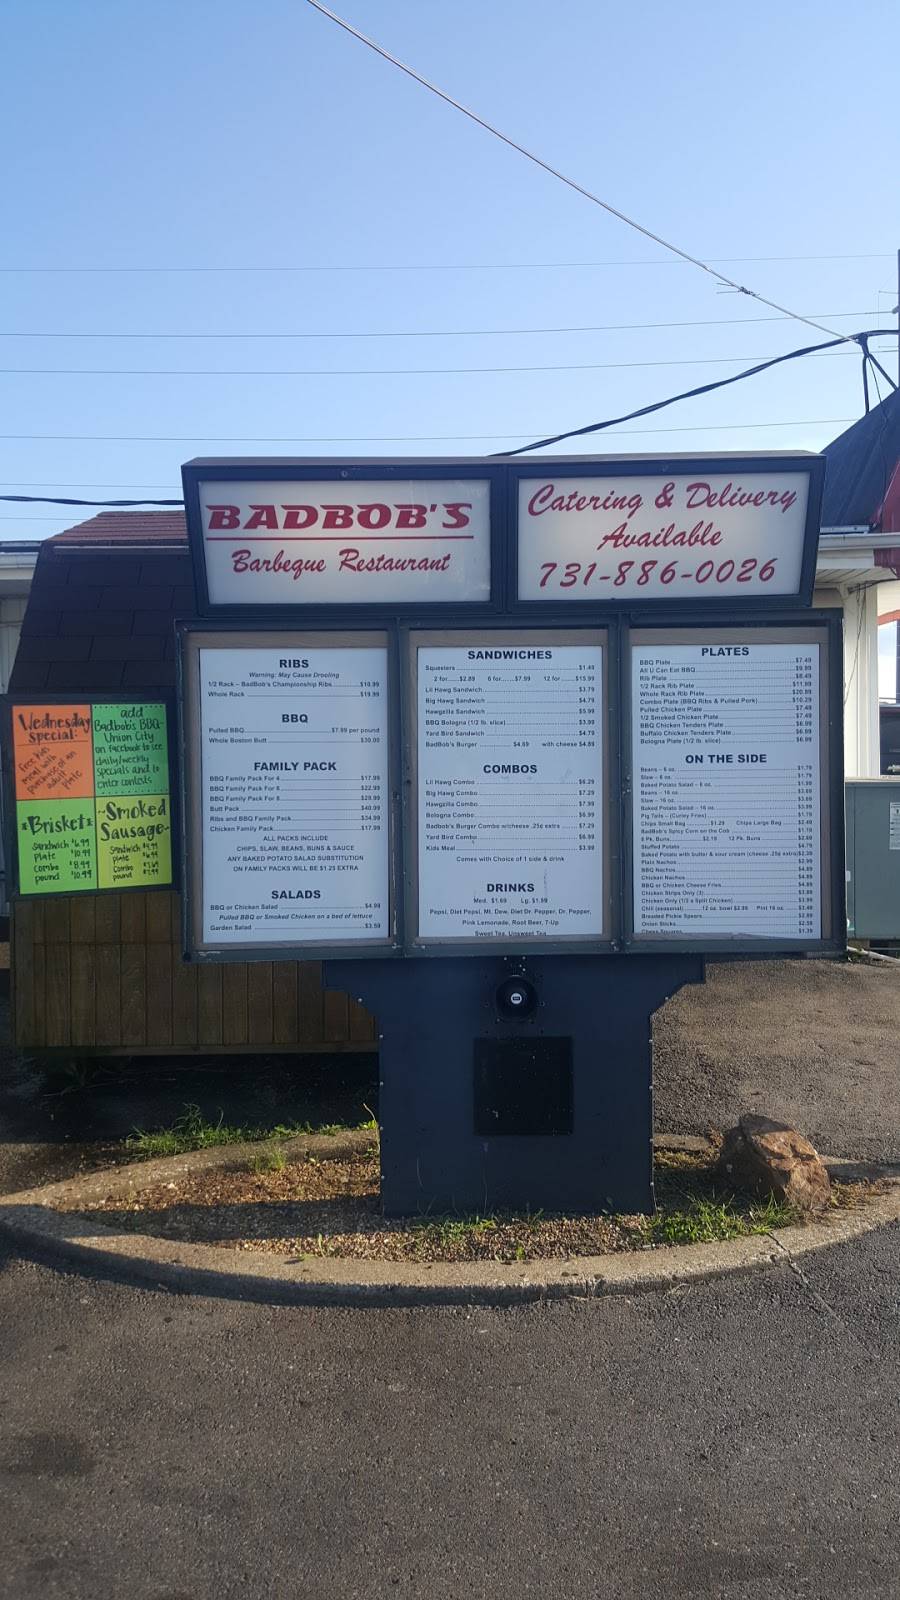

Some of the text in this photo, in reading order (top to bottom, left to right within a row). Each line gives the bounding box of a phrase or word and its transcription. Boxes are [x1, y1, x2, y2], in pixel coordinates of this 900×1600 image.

[528, 482, 797, 518] Catering & Delivery
[205, 504, 472, 530] BADBOB'S
[597, 521, 722, 550] Available
[232, 549, 450, 580] Barbeque Restaurant
[540, 558, 778, 587] 731-886-0026
[468, 651, 552, 660] SANDWICHES
[702, 647, 749, 656] PLATES
[279, 659, 309, 668] RIBS
[121, 707, 143, 718] add
[18, 712, 91, 733] Wednesday
[282, 714, 308, 723] BBQ
[104, 731, 154, 743] Union City
[95, 745, 106, 753] on
[685, 754, 767, 763] ON THE SIDE
[254, 762, 336, 771] FAMILY PACK
[483, 765, 537, 773] COMBOS
[106, 799, 166, 821] Smoked
[100, 823, 164, 841] Sausage
[34, 852, 56, 862] plate
[34, 864, 59, 872] combo
[35, 872, 59, 885] pound
[487, 884, 535, 892] DRINKS
[271, 890, 321, 899] SALADS
